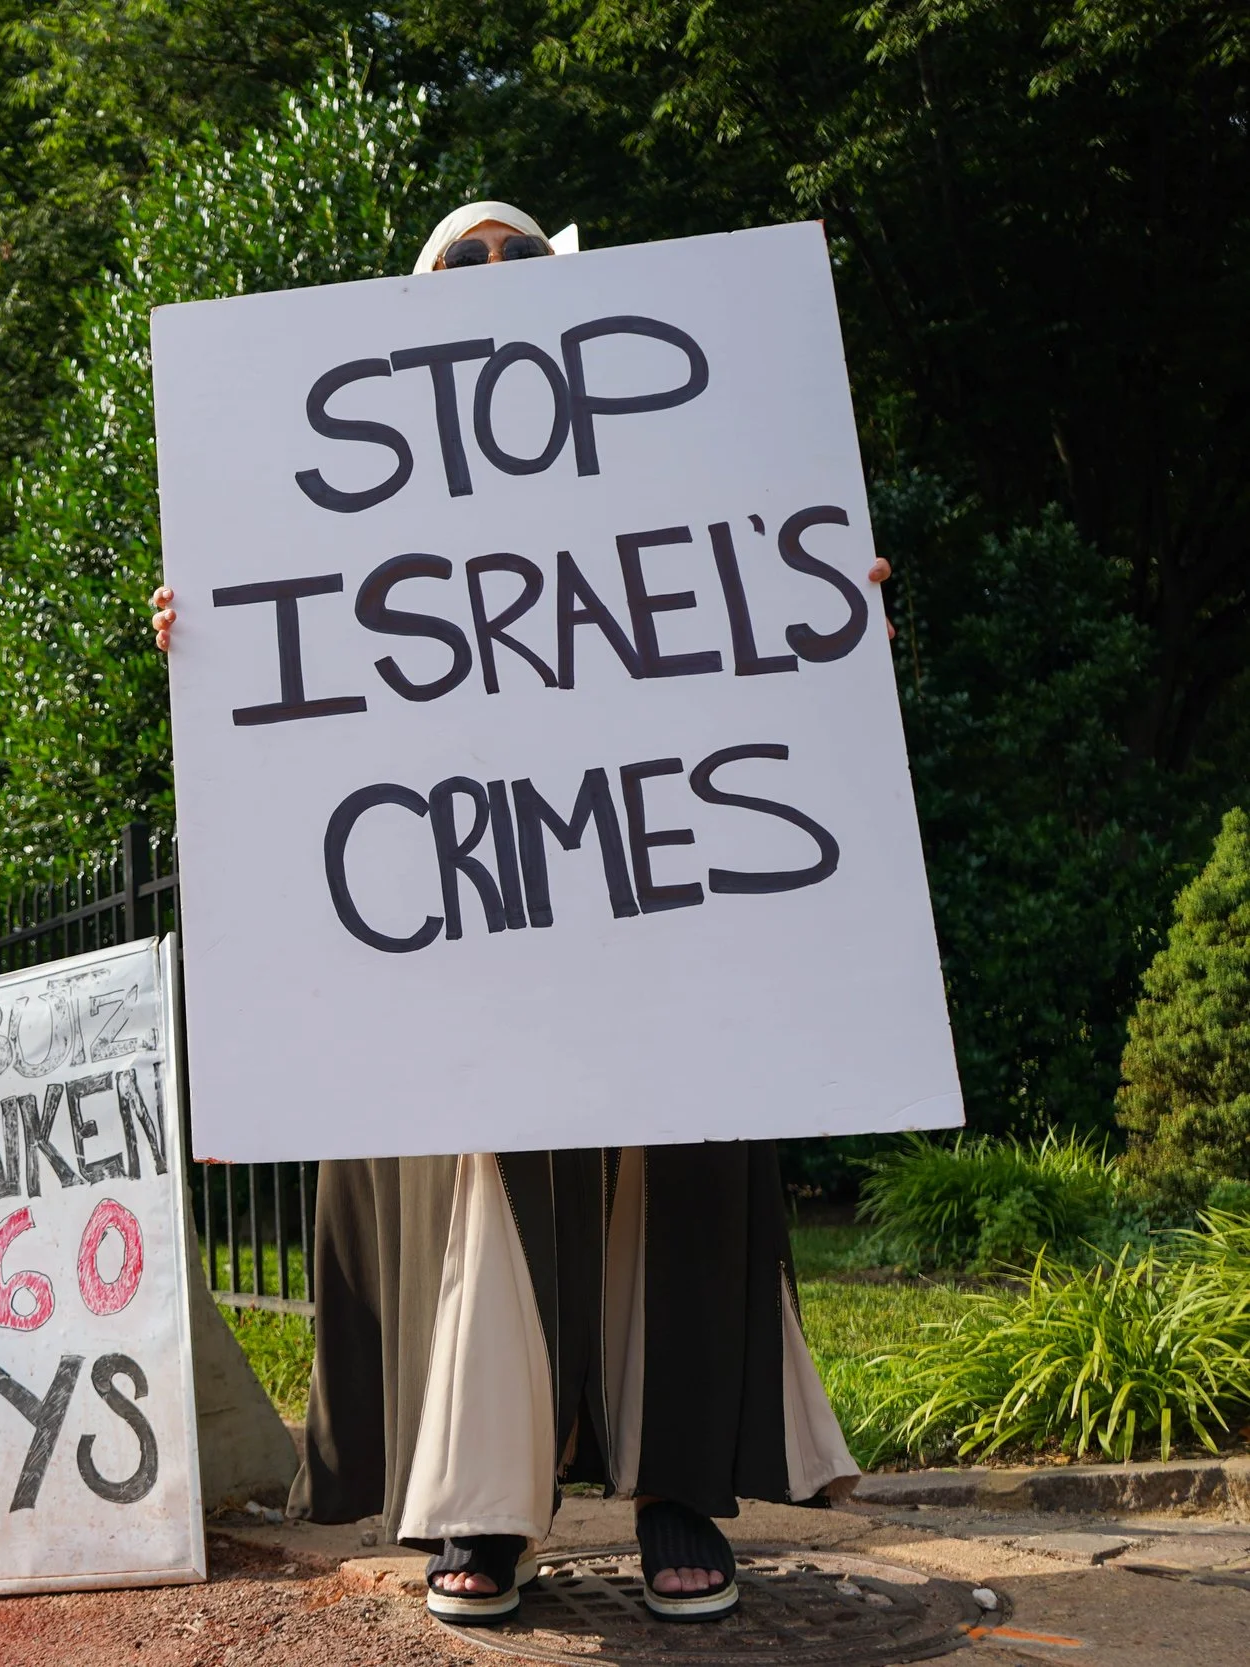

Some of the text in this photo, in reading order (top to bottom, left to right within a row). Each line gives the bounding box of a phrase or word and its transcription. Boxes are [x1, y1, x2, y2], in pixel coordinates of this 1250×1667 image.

[296, 315, 710, 513] STOP
[213, 506, 869, 726] ISRAEL'S
[324, 744, 840, 953] CRIMES
